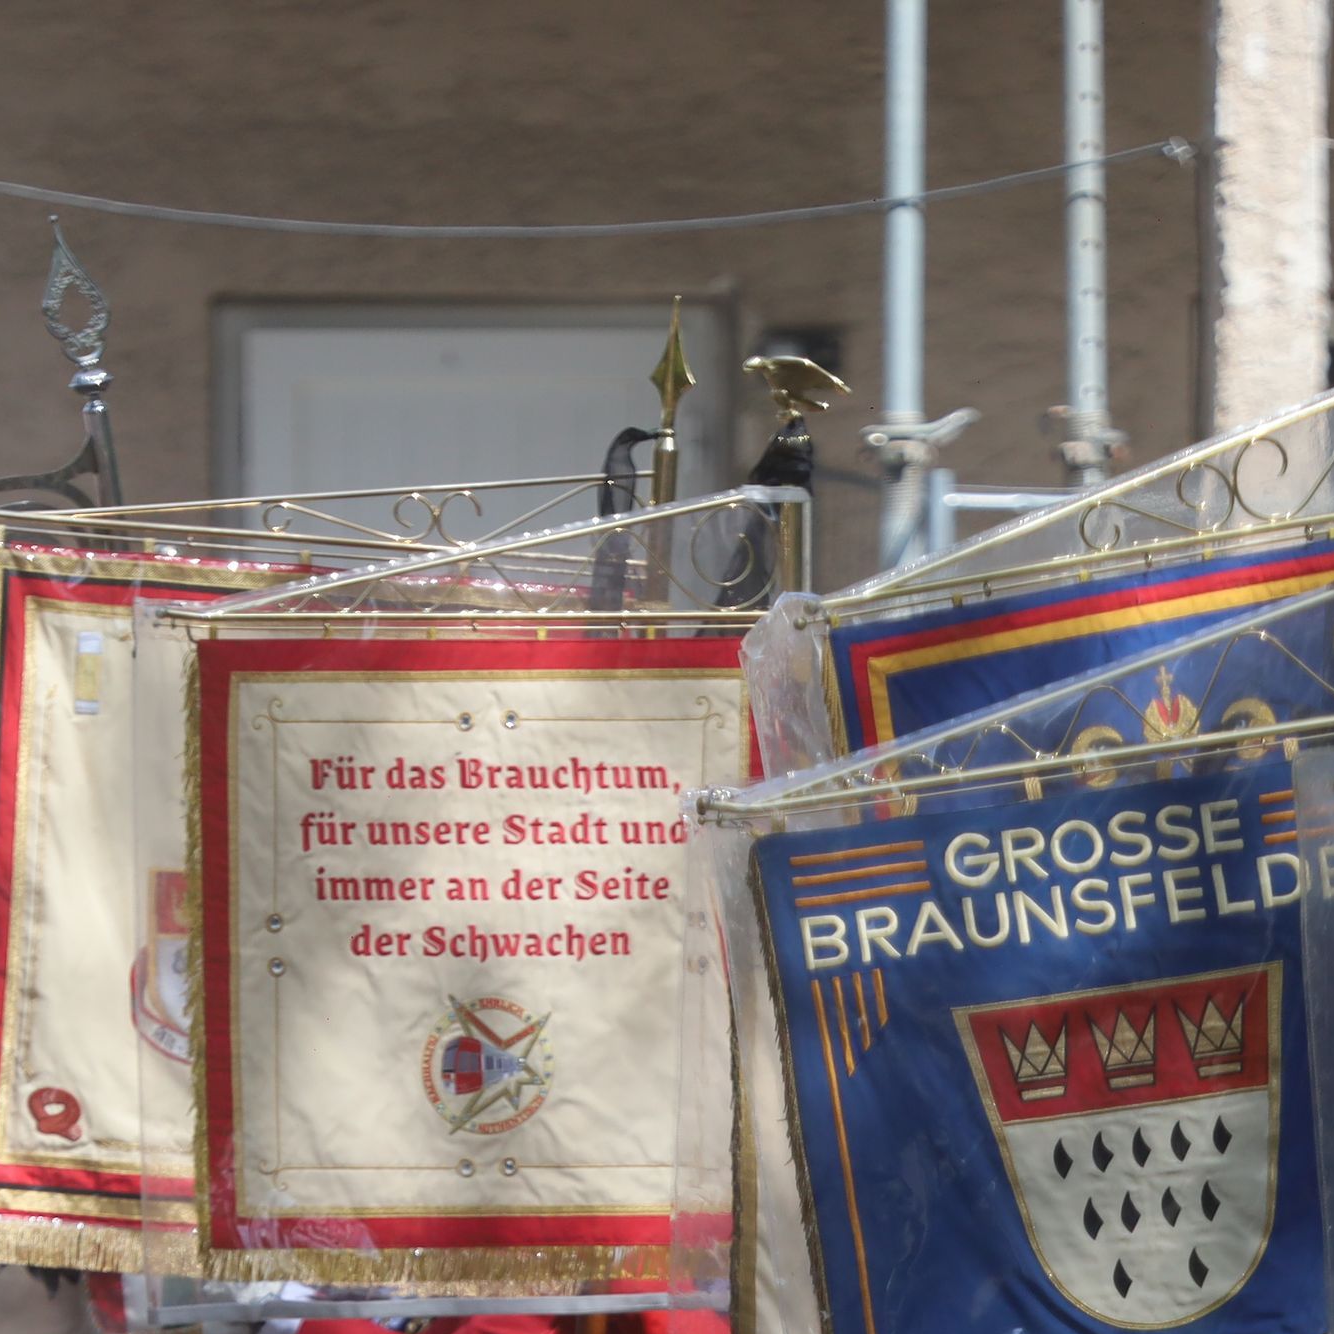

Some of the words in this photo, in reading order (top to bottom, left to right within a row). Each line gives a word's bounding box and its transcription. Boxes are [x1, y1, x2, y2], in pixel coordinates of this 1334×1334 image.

[309, 755, 376, 791] Für
[386, 757, 447, 791] das
[456, 757, 682, 795] Brauchtum,
[298, 811, 357, 853] für
[366, 820, 491, 846] unsere
[502, 813, 609, 846] Stadt
[619, 812, 689, 846] und
[944, 798, 1245, 889] GROSSE
[314, 866, 435, 902] immer
[445, 876, 490, 902] an
[501, 868, 563, 902] der
[574, 866, 671, 902] Seite
[349, 924, 412, 957] der
[421, 924, 631, 963] Schwachen
